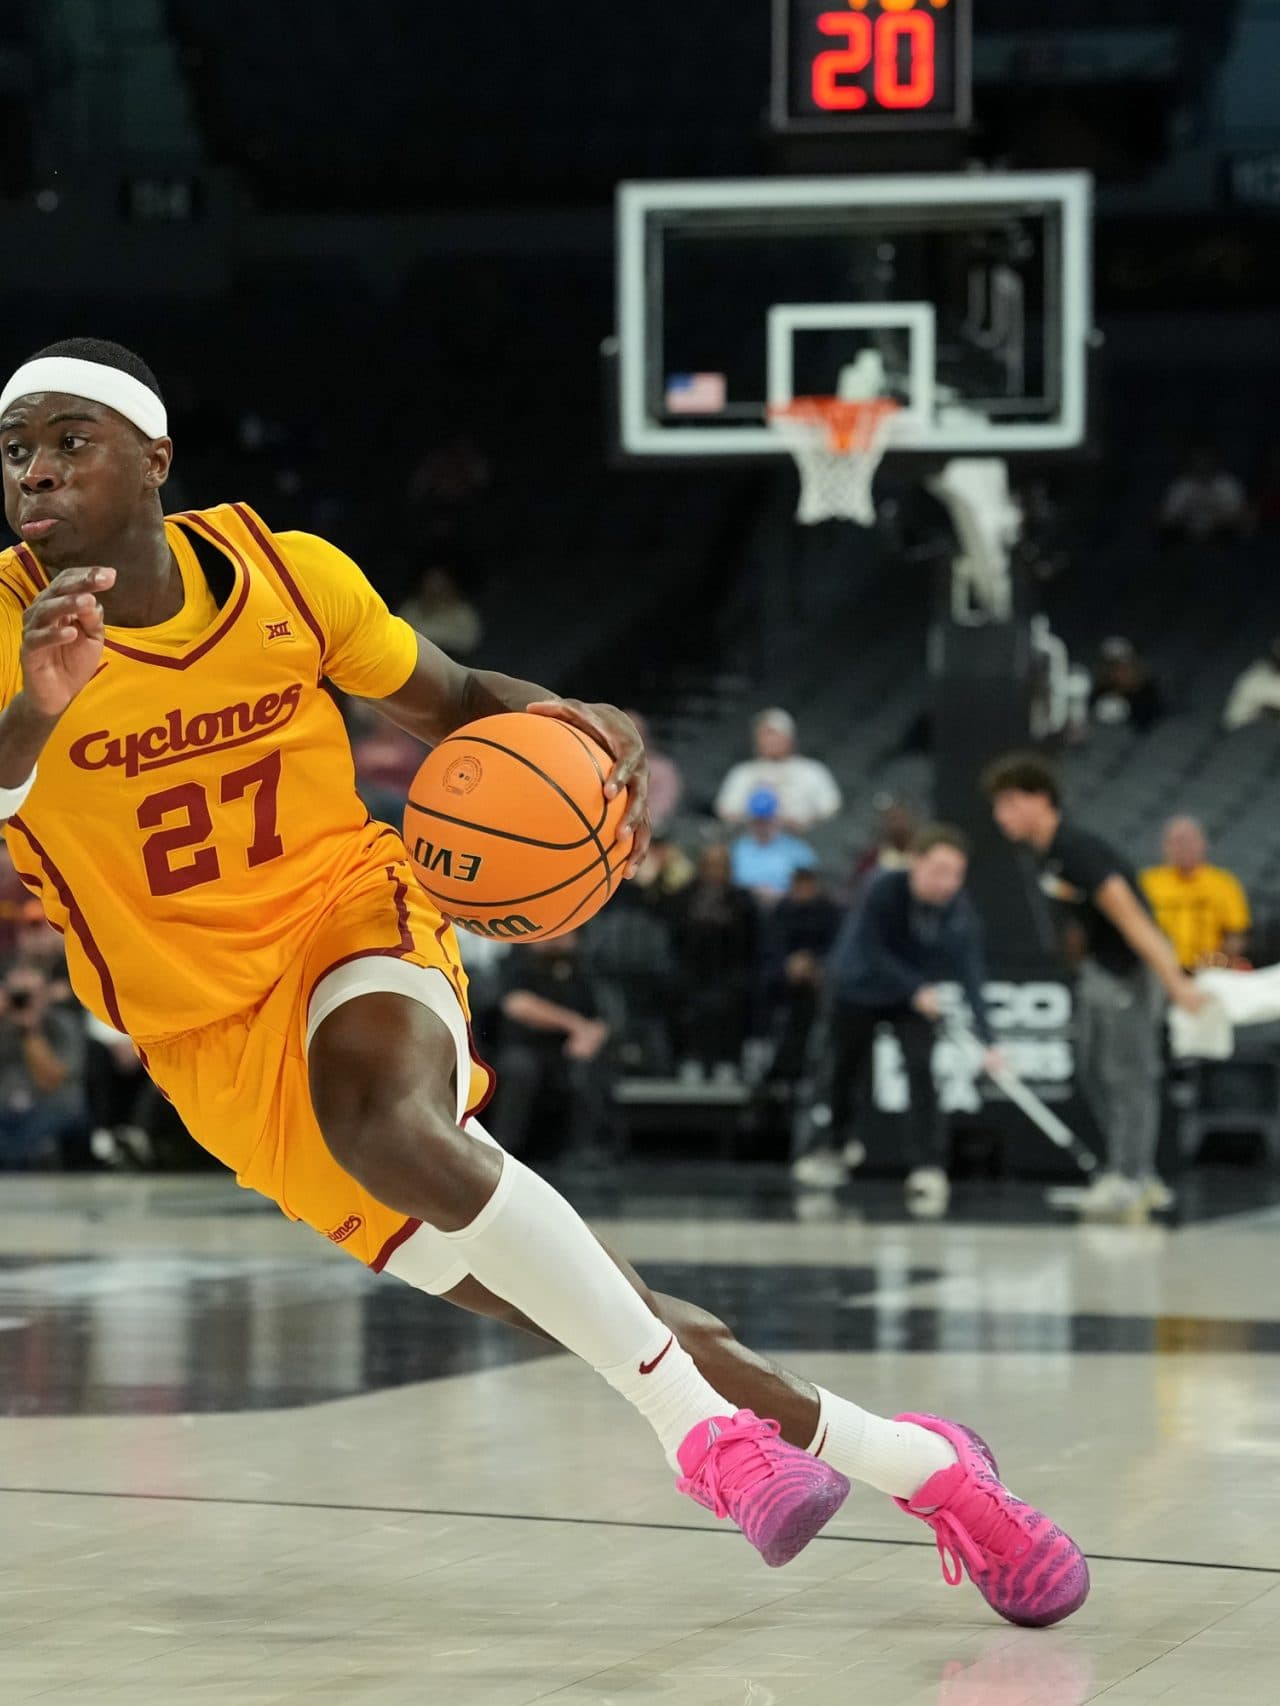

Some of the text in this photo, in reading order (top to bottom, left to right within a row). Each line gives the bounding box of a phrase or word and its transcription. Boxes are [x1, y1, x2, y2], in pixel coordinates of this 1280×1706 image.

[812, 9, 935, 110] 20
[69, 683, 303, 778] Cyclones
[136, 748, 285, 896] 27
